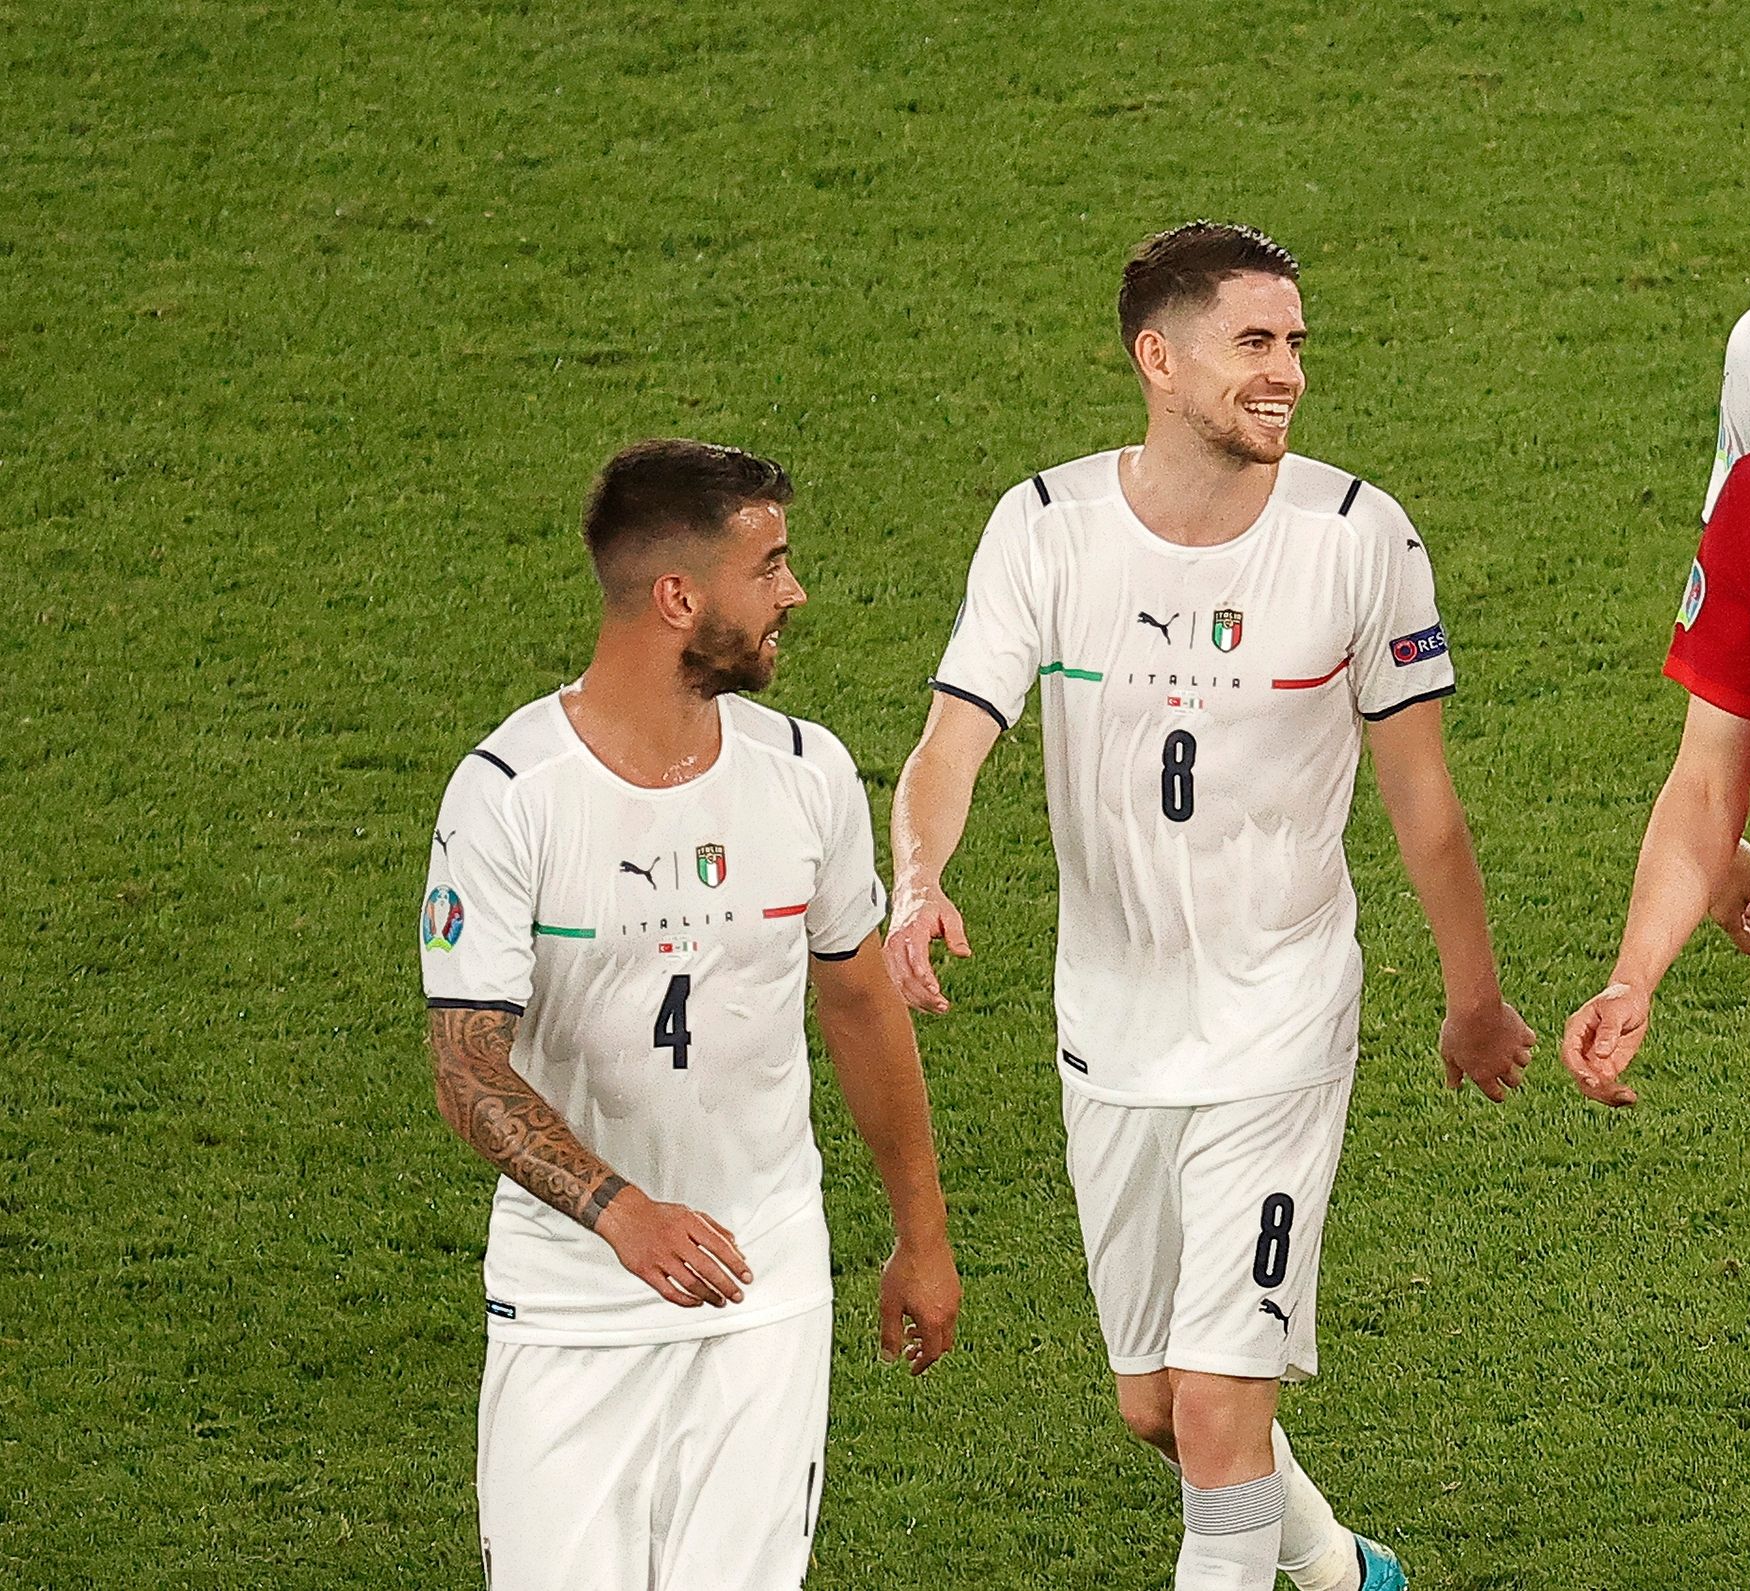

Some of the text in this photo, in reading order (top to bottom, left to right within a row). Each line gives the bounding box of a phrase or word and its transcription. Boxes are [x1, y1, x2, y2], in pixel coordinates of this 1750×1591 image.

[1128, 673, 1241, 689] ITALIA
[1161, 728, 1197, 823] 8
[622, 911, 733, 935] ITALIA
[653, 974, 692, 1070] 4
[1252, 1192, 1295, 1289] 8
